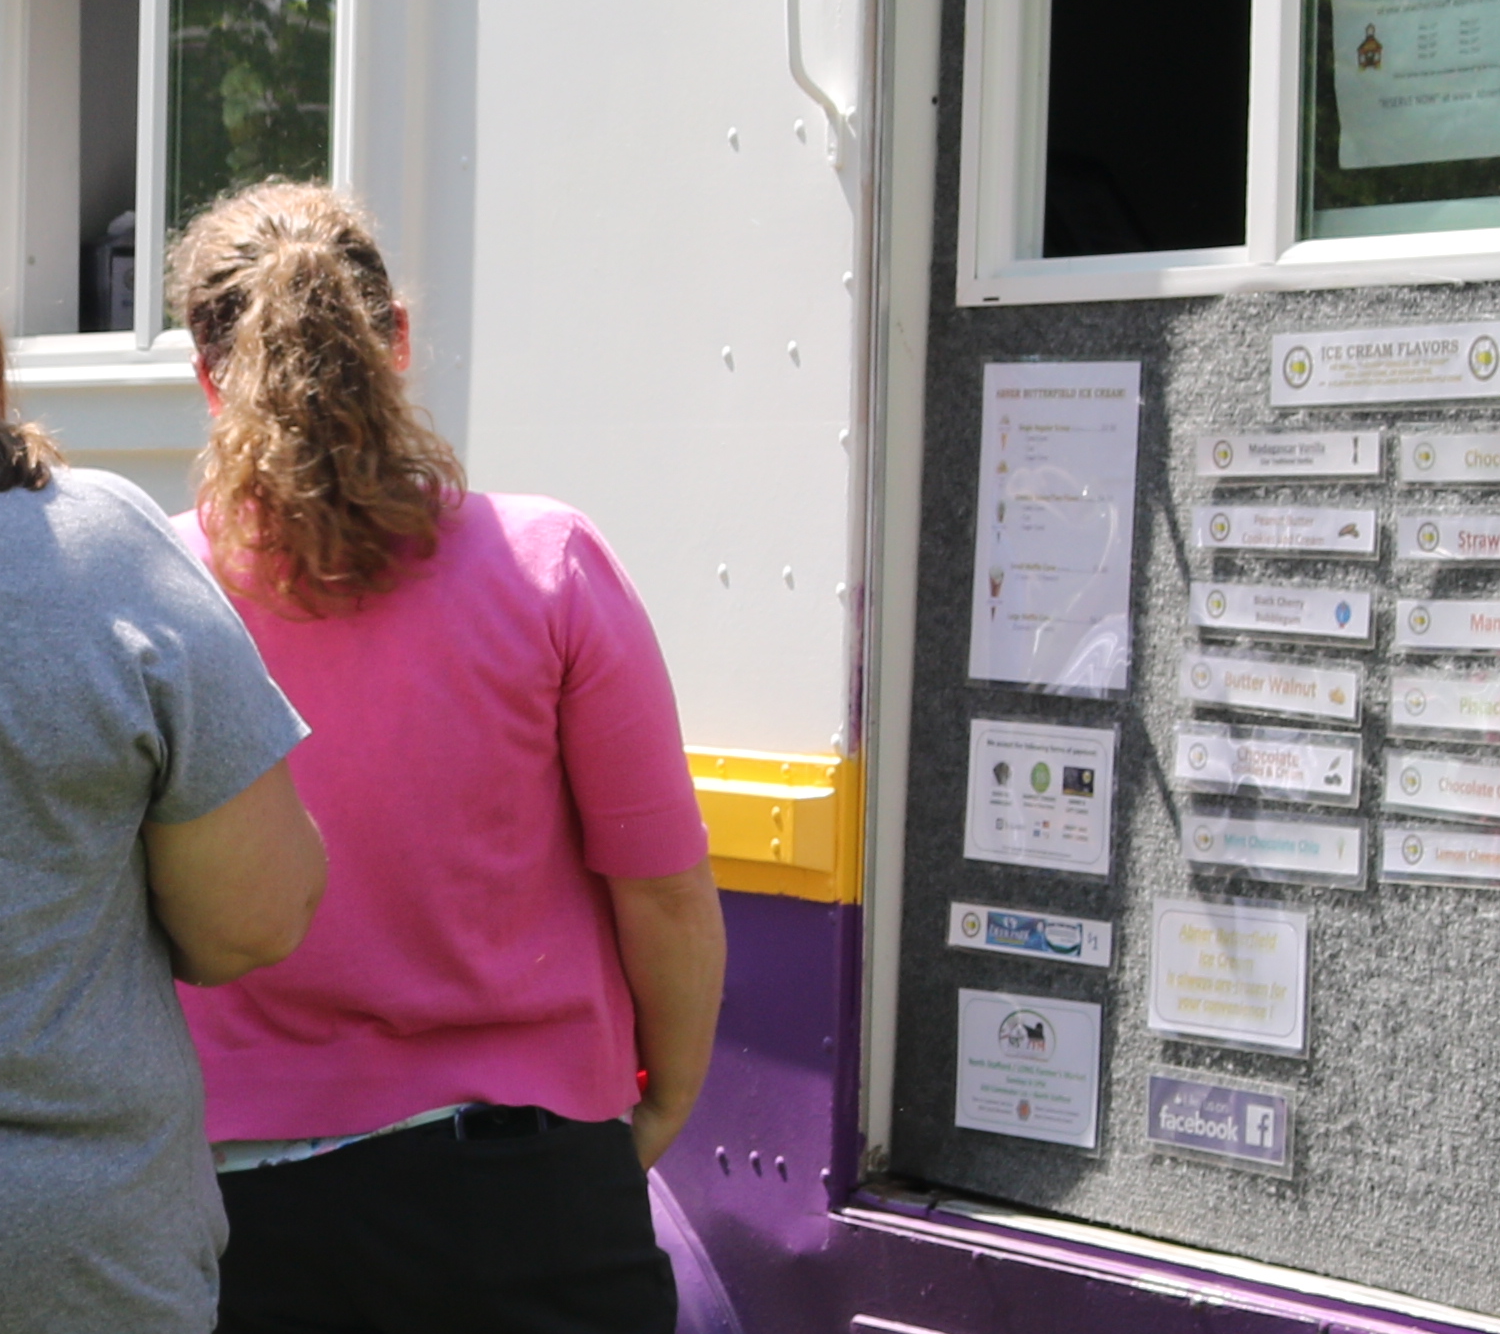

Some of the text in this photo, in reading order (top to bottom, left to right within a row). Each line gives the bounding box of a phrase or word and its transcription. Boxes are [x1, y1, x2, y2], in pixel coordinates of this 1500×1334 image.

[1321, 339, 1460, 361] ICE CREAM FLAVORS
[1249, 442, 1325, 456] Madagascar Vanilla
[1297, 534, 1326, 546] Cream
[1254, 595, 1305, 610] Black Cherry
[1224, 671, 1318, 698] Butter Walnut
[1237, 745, 1300, 767] Chocolate
[1438, 777, 1494, 798] Chocolate
[1180, 924, 1212, 942] Abner
[1200, 952, 1215, 967] Ice
[1271, 982, 1287, 999] for
[1159, 1105, 1239, 1142] facebook
